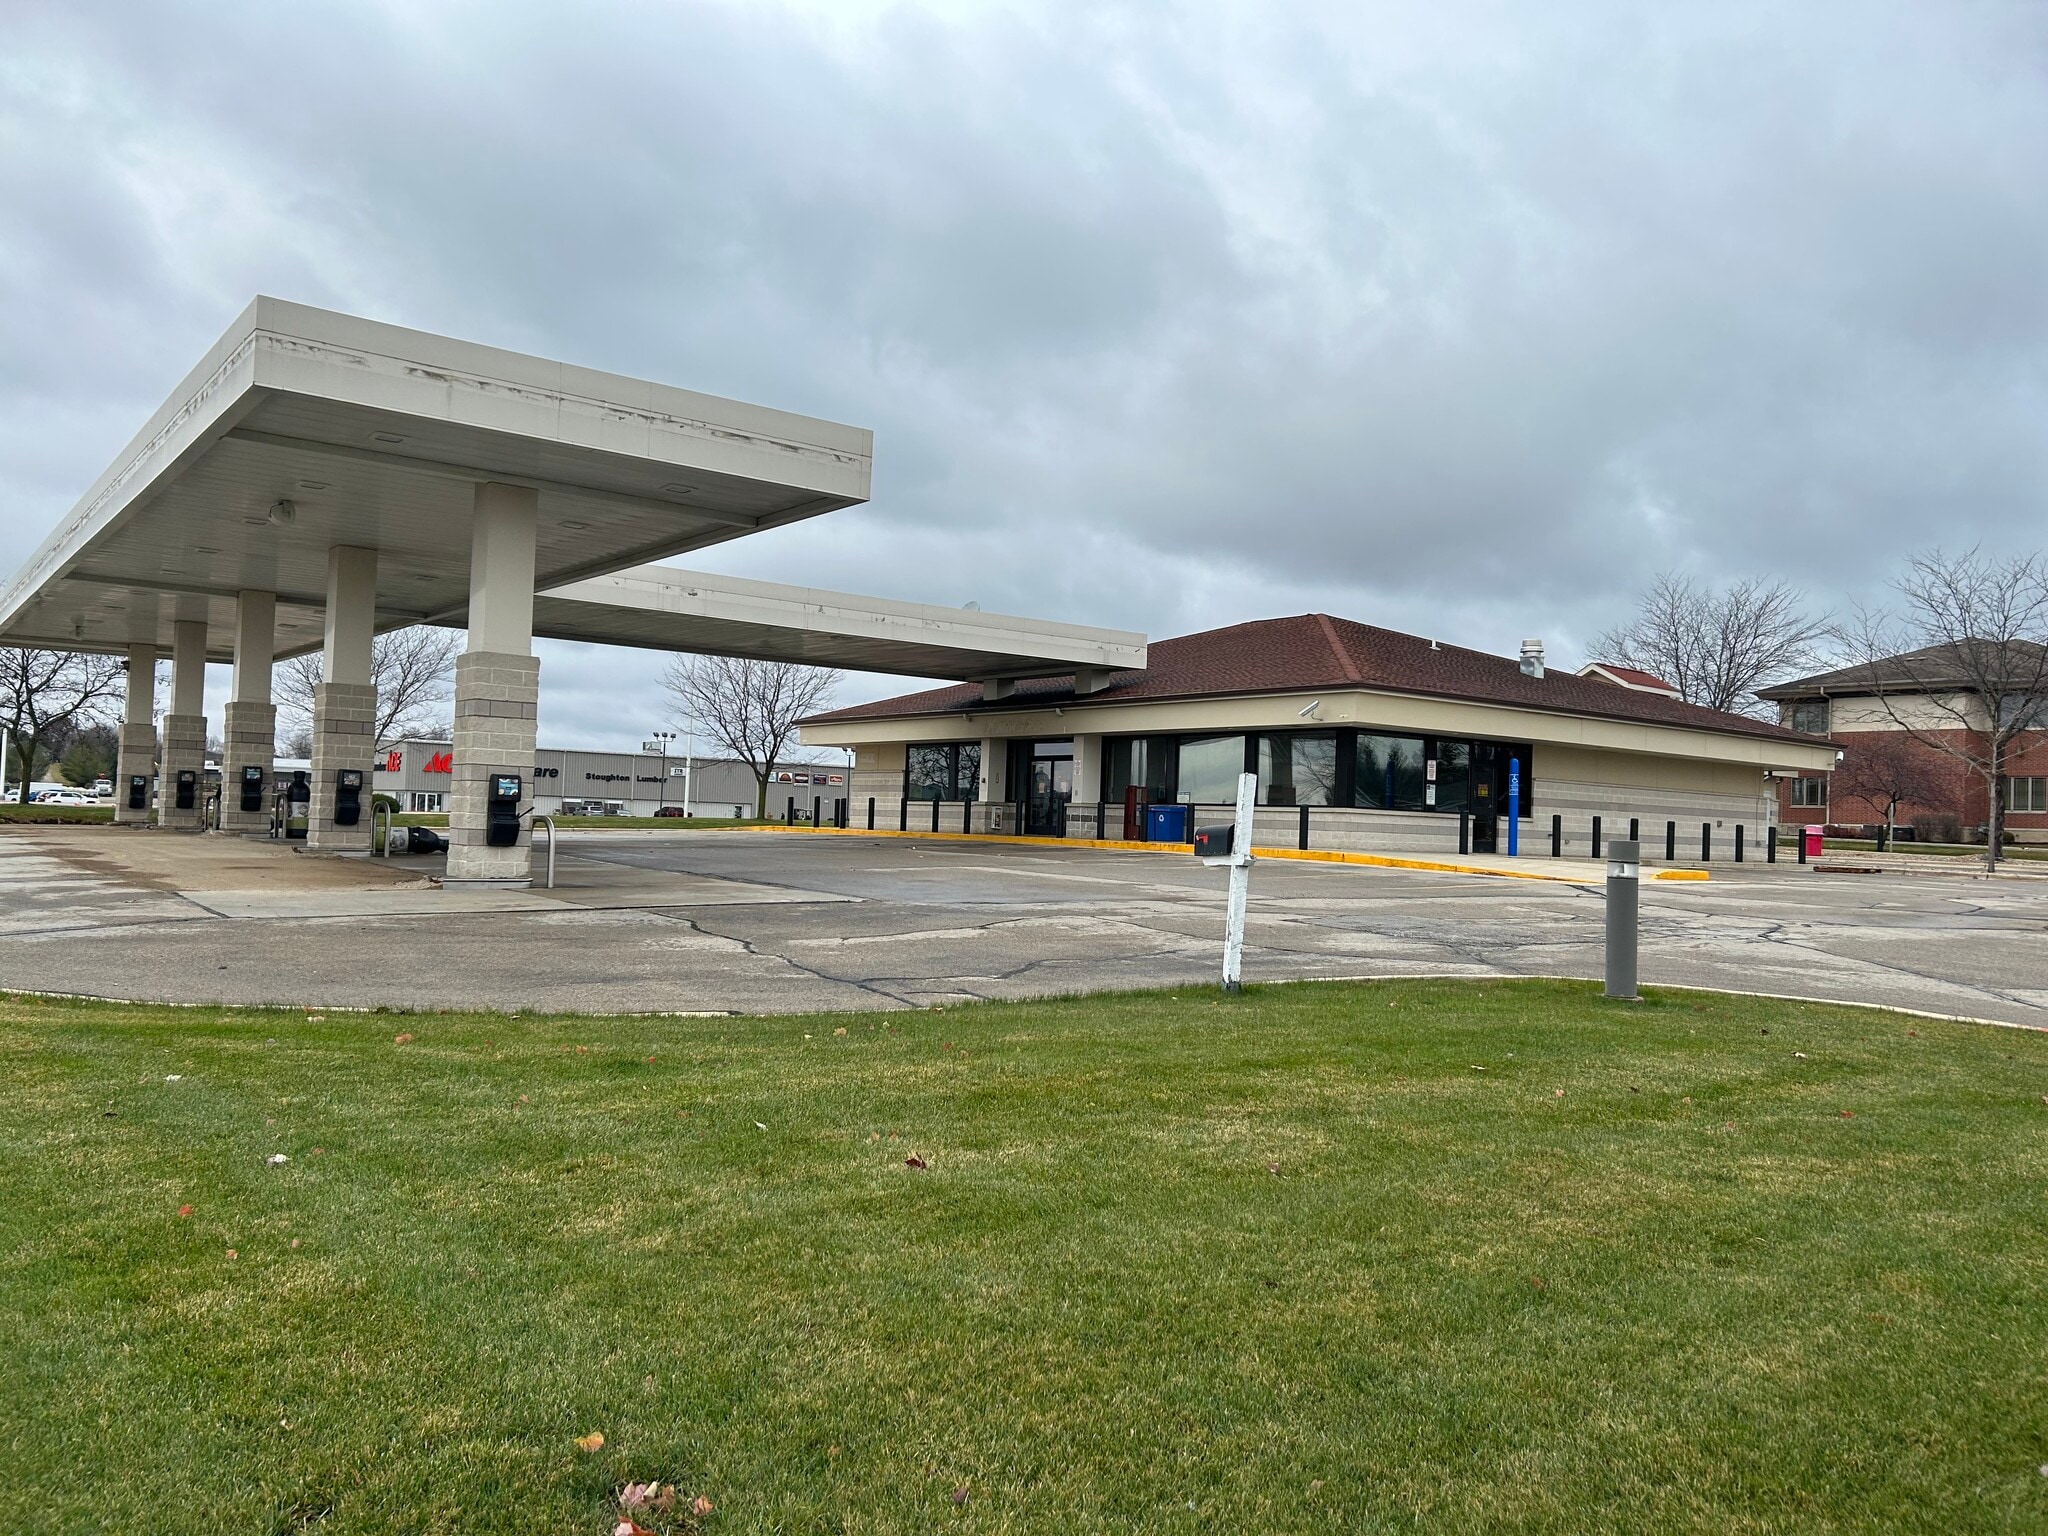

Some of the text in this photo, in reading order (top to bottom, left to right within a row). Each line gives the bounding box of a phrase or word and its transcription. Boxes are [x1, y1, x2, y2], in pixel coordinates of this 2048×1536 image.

[423, 751, 559, 778] AC are
[585, 772, 630, 783] Stoughton
